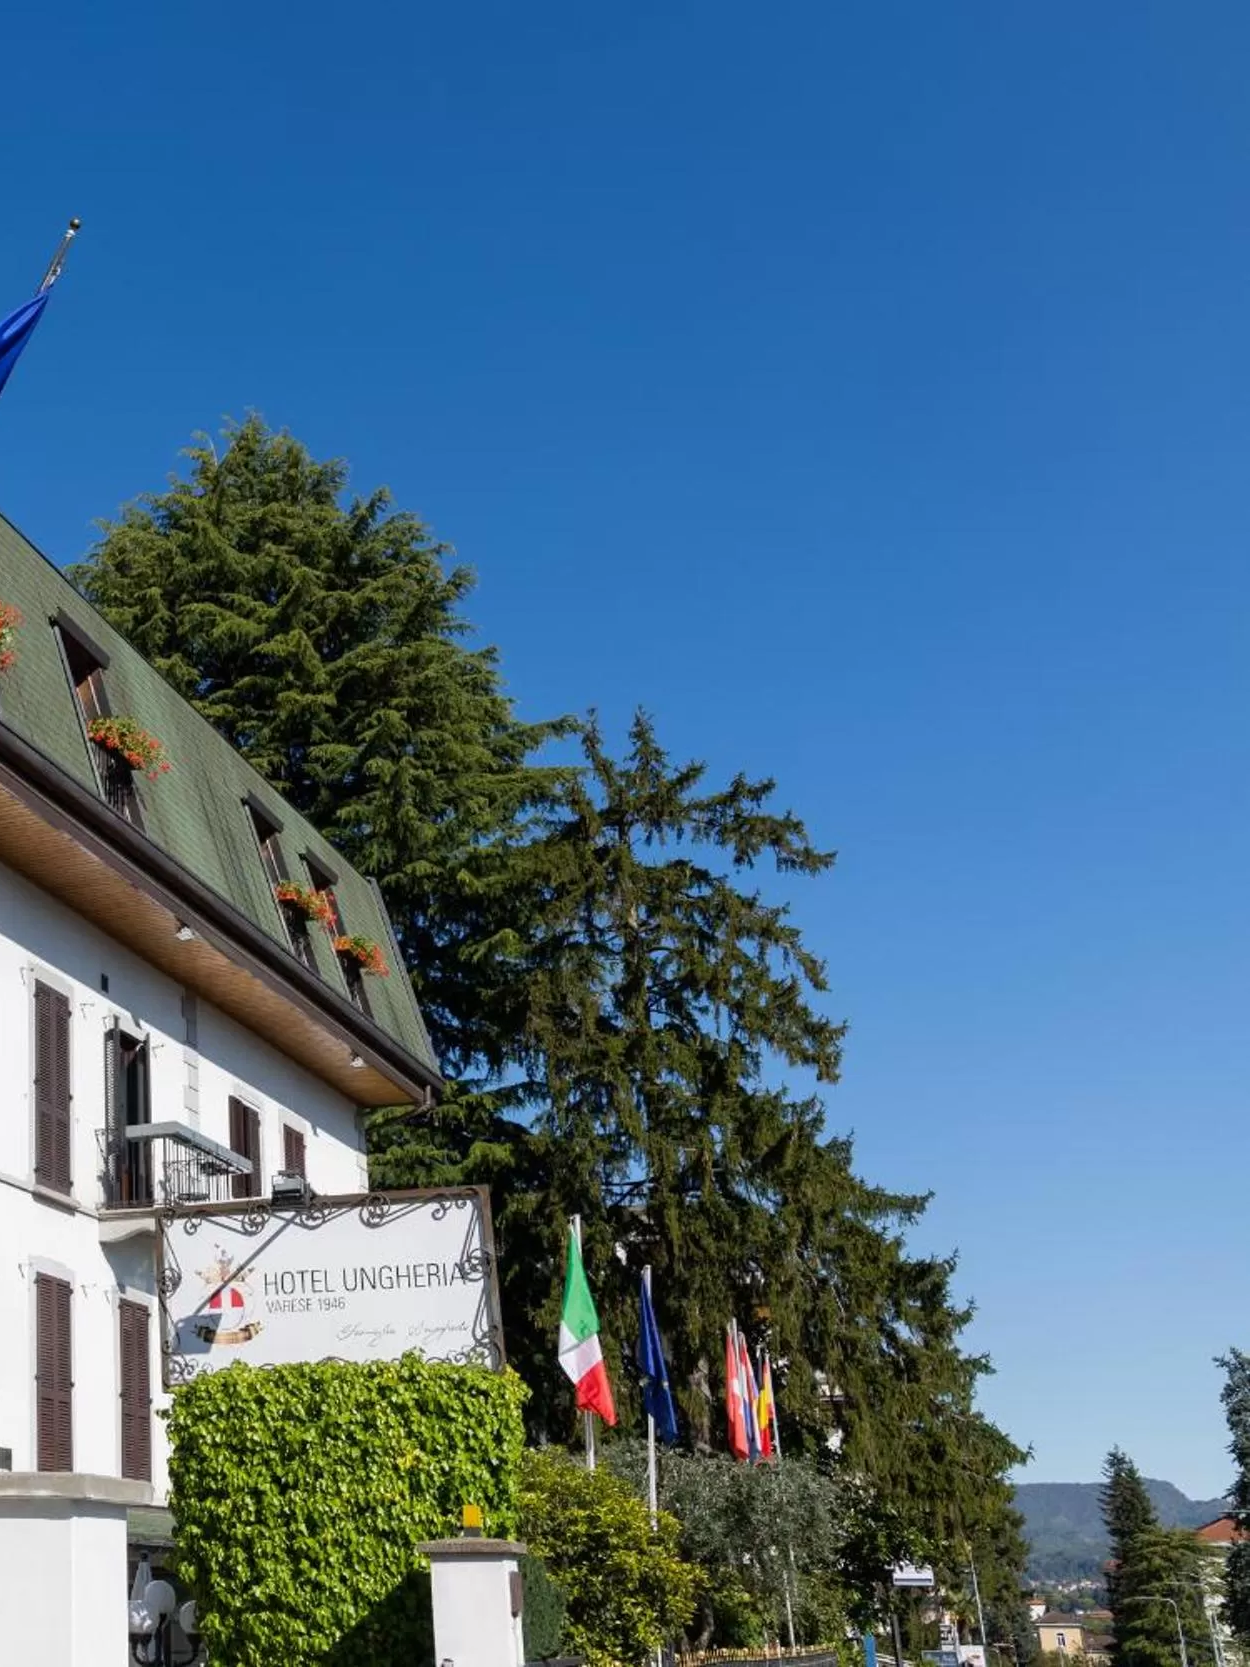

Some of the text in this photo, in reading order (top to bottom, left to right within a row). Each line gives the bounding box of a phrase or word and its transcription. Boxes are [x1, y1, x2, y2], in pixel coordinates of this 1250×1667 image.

[264, 1262, 467, 1296] HOTEL UNGHERIA
[265, 1297, 346, 1313] VARESE 1946
